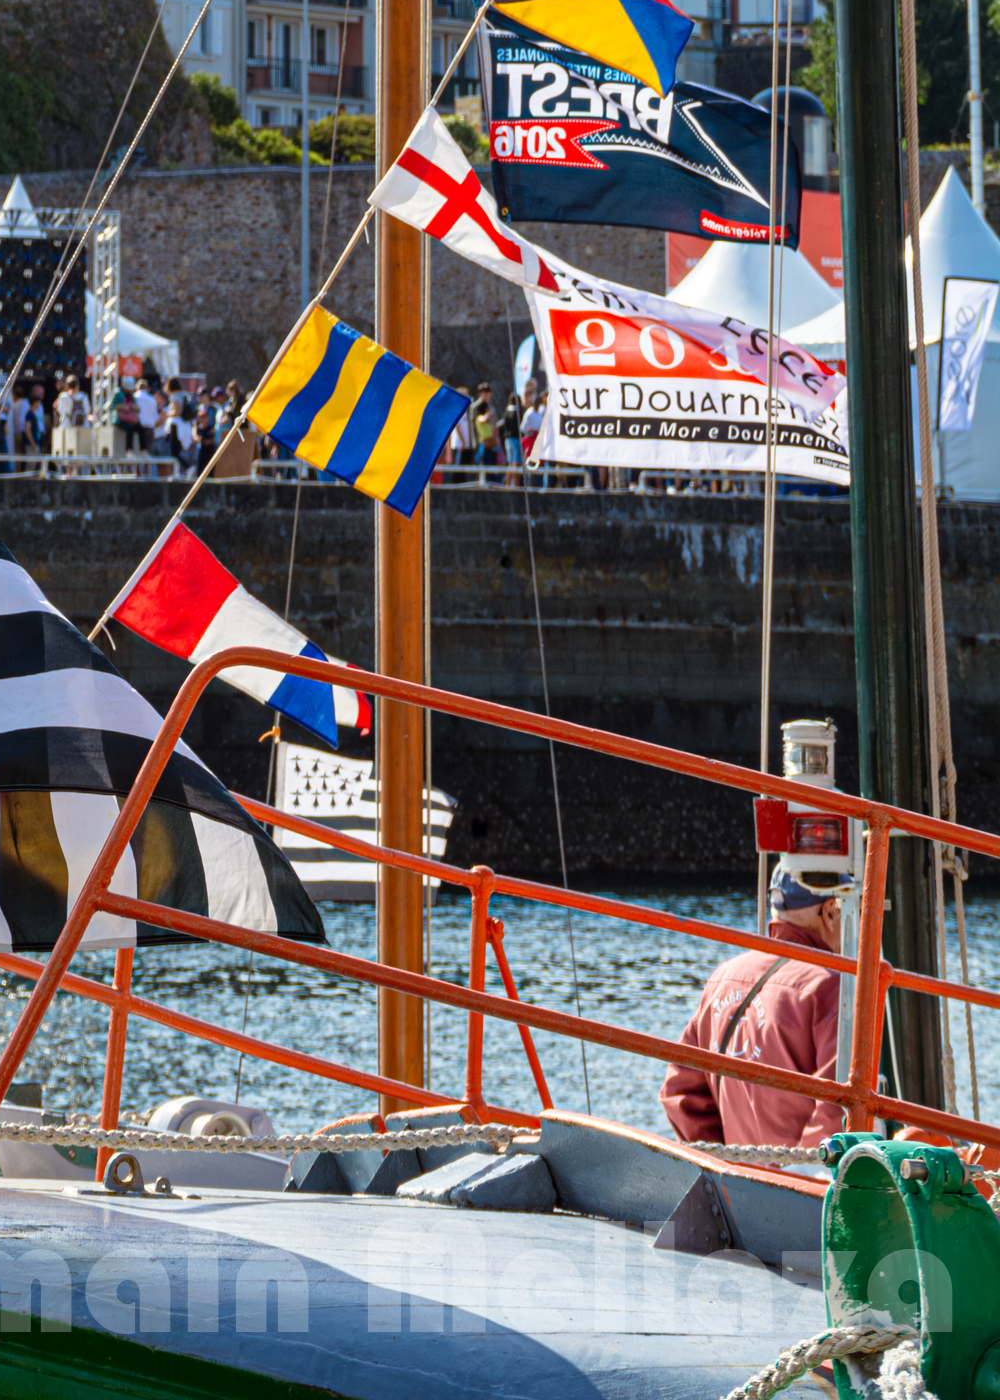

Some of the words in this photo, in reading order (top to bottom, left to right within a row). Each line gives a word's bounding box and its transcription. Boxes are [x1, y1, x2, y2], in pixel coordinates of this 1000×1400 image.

[559, 387, 609, 410] sur
[564, 419, 620, 436] Gouel
[628, 423, 651, 437] ar
[659, 421, 701, 439] Mor
[708, 426, 719, 440] e
